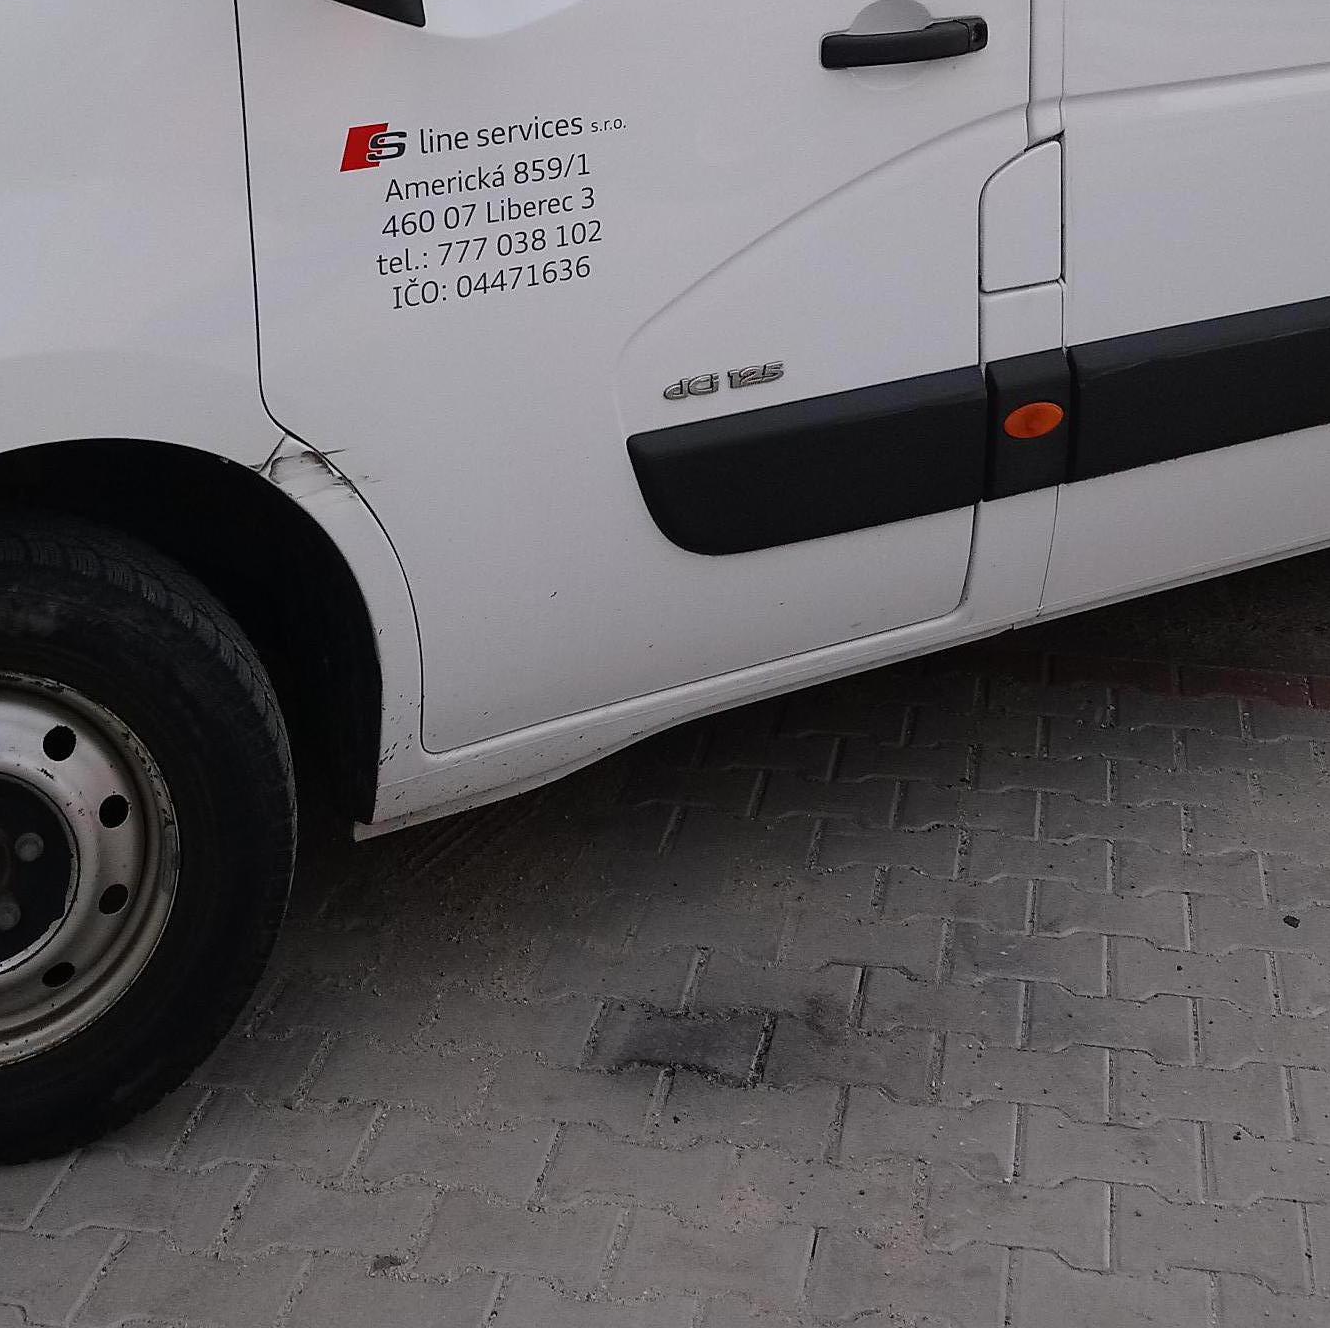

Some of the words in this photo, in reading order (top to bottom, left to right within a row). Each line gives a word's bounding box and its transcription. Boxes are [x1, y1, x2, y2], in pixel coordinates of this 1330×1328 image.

[419, 128, 469, 155] line
[476, 115, 583, 148] services
[590, 118, 627, 134] s.r.o.
[384, 163, 506, 203] Americká
[513, 153, 591, 185] 859/1
[381, 209, 435, 238] 460
[443, 203, 477, 230] 07
[486, 195, 574, 224] Liberec
[581, 186, 595, 210] 3
[375, 247, 428, 276] tel.:
[437, 236, 488, 267] 777
[496, 228, 547, 257] 038
[556, 219, 603, 248] 102
[392, 277, 448, 310] IČO:
[456, 255, 591, 298] 04471636
[663, 372, 720, 401] dCi
[727, 360, 785, 389] 125
